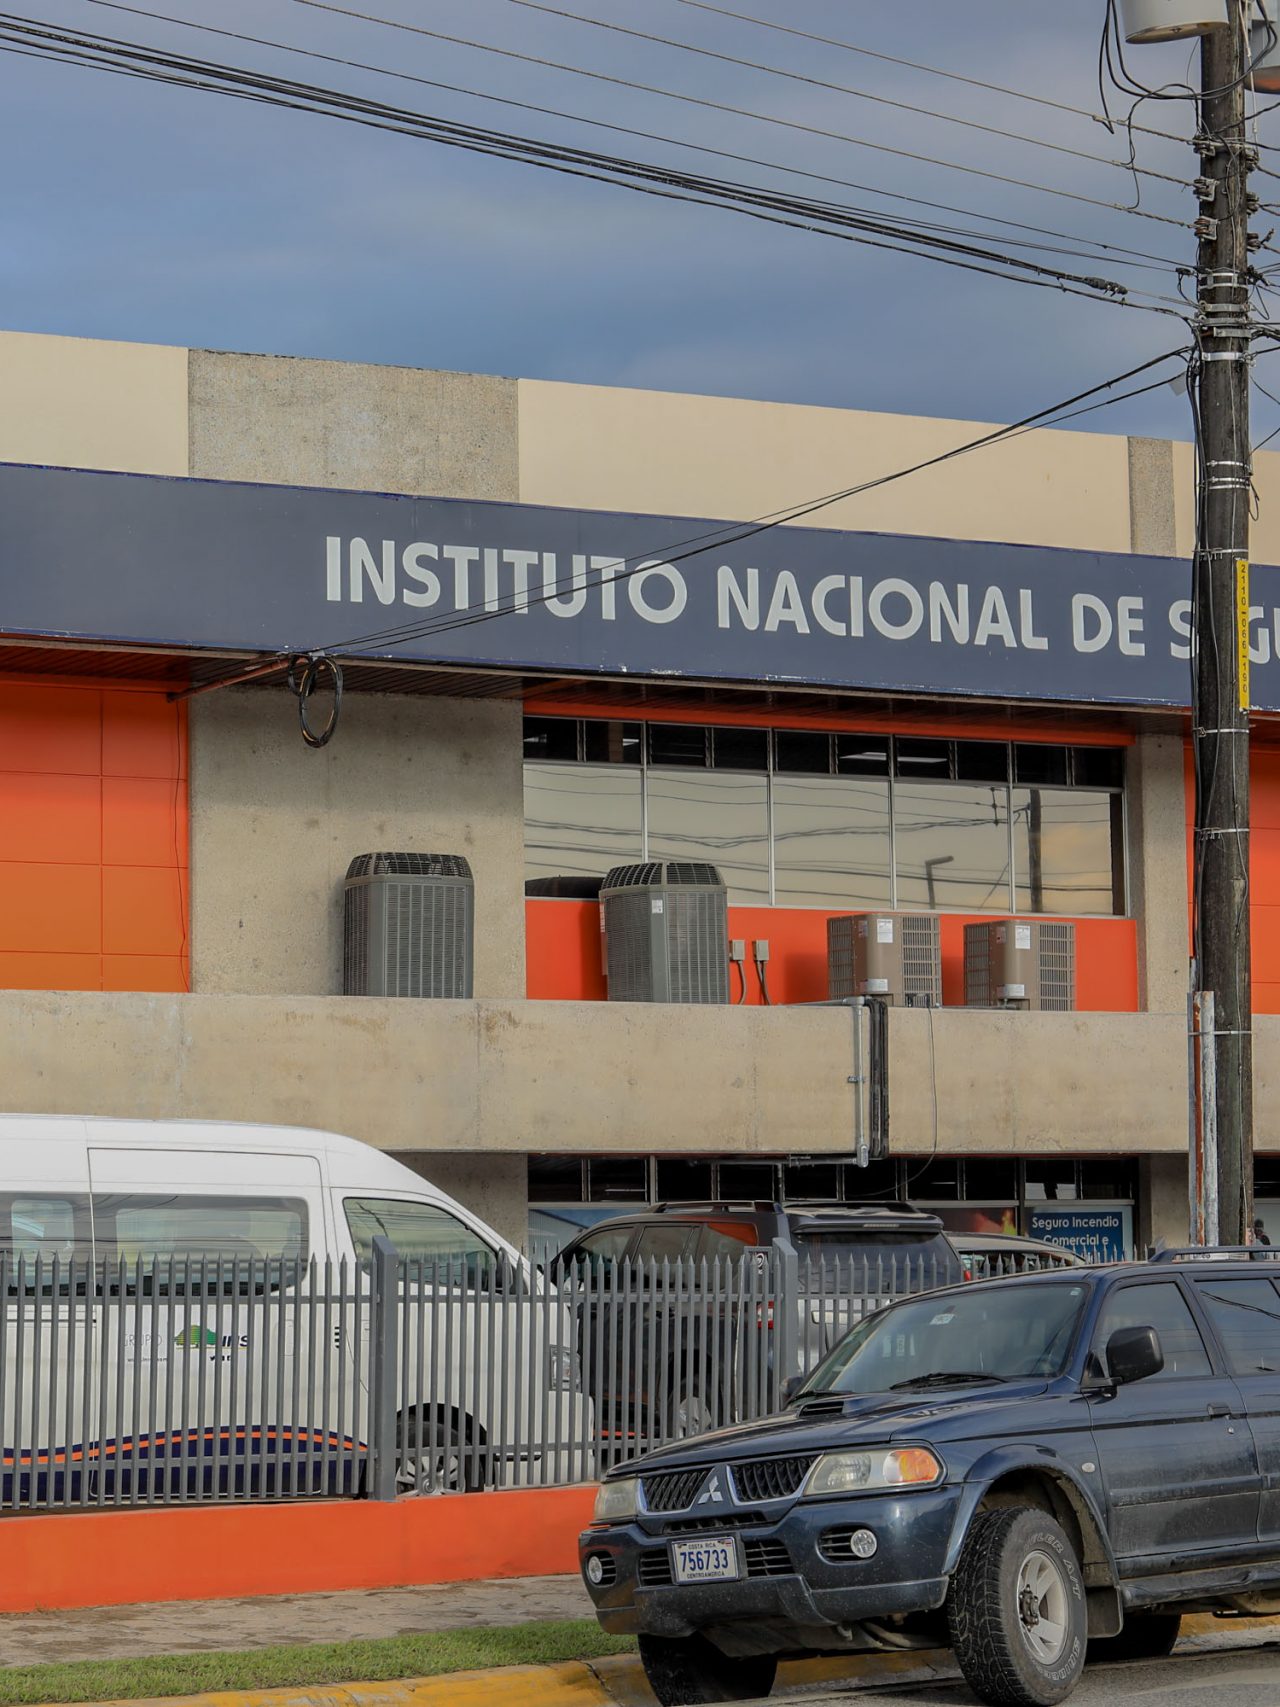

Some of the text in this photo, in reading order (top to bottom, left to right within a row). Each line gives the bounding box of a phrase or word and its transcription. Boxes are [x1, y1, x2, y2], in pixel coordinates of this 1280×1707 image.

[326, 536, 1280, 665] INSTITUTO NACIONAL DE SG
[1032, 1216, 1119, 1231] Seguro Incendio
[1043, 1234, 1109, 1246] Comercial e
[680, 1549, 729, 1573] 756733
